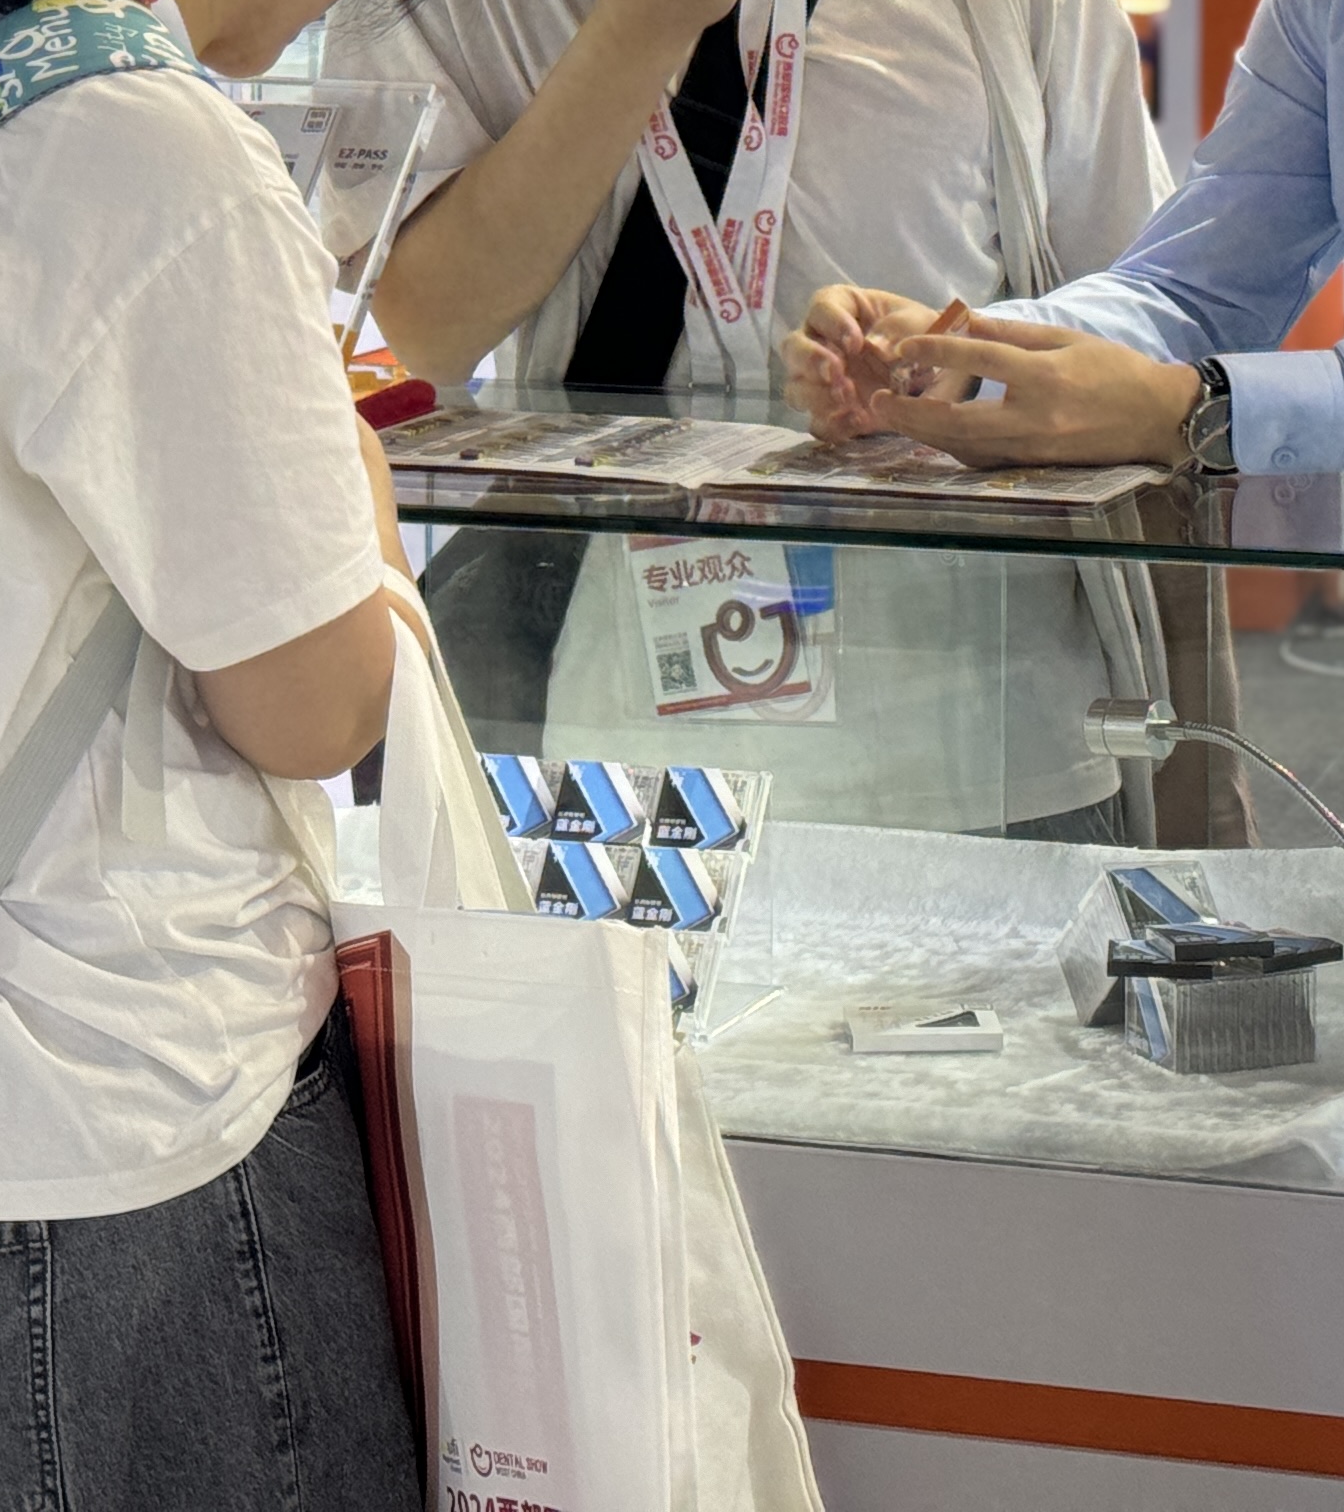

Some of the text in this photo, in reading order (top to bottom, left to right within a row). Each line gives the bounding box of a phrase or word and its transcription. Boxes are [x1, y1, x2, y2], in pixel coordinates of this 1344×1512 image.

[26, 3, 80, 85] Menu
[338, 148, 389, 160] EZ-PASS
[643, 550, 754, 592] 专业观众
